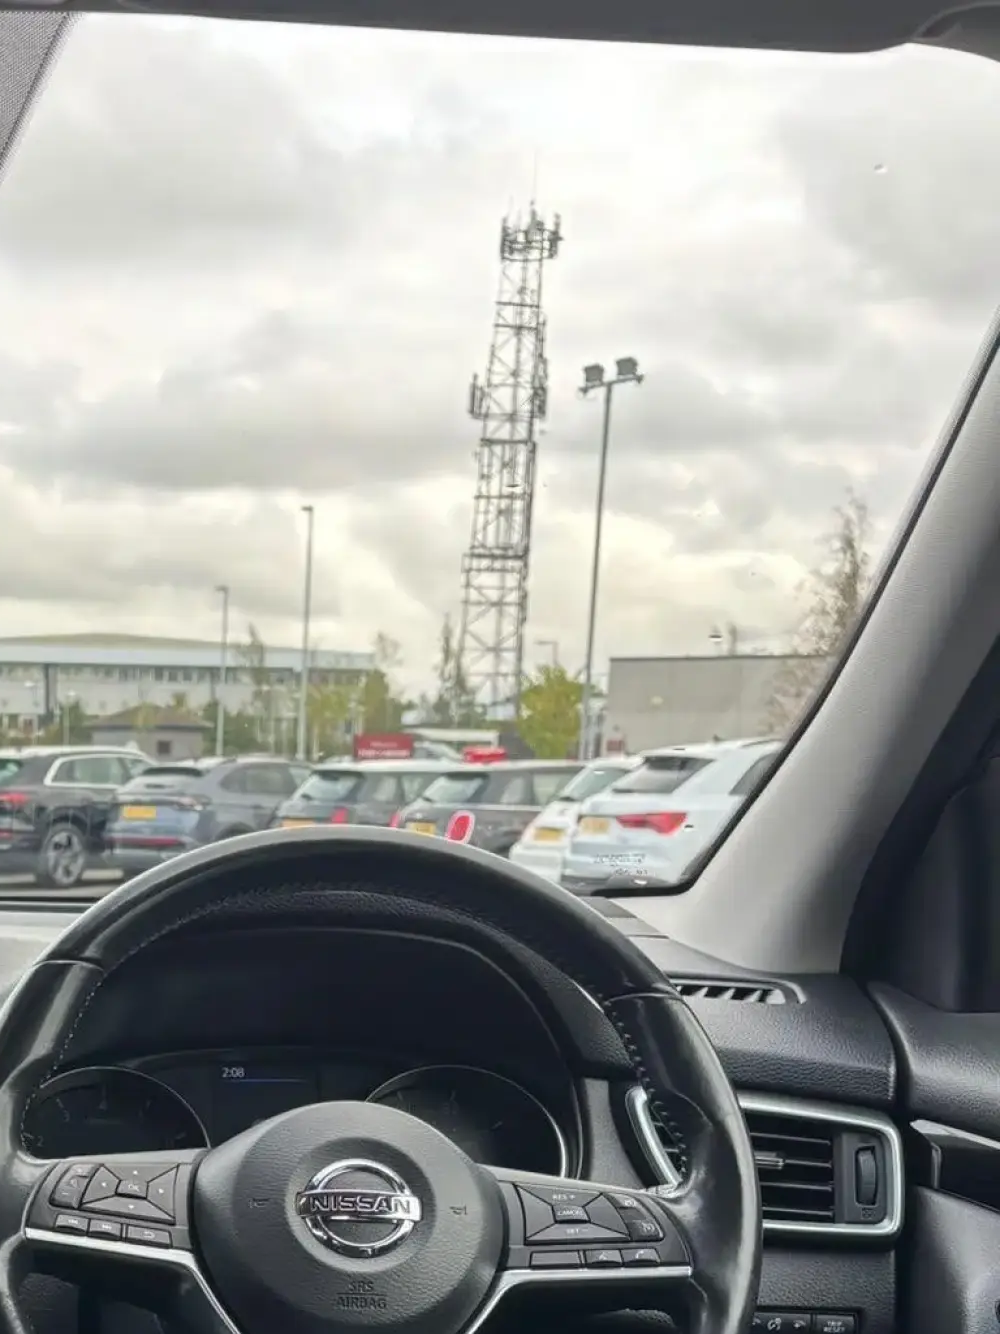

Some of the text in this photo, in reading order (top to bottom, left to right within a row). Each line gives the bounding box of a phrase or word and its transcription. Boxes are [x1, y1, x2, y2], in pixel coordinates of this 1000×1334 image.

[222, 1067, 244, 1078] 2:08
[309, 1194, 412, 1215] NISSAN
[348, 1280, 375, 1293] SRS
[336, 1296, 388, 1310] AIRBAG
[823, 1326, 846, 1334] RESET
